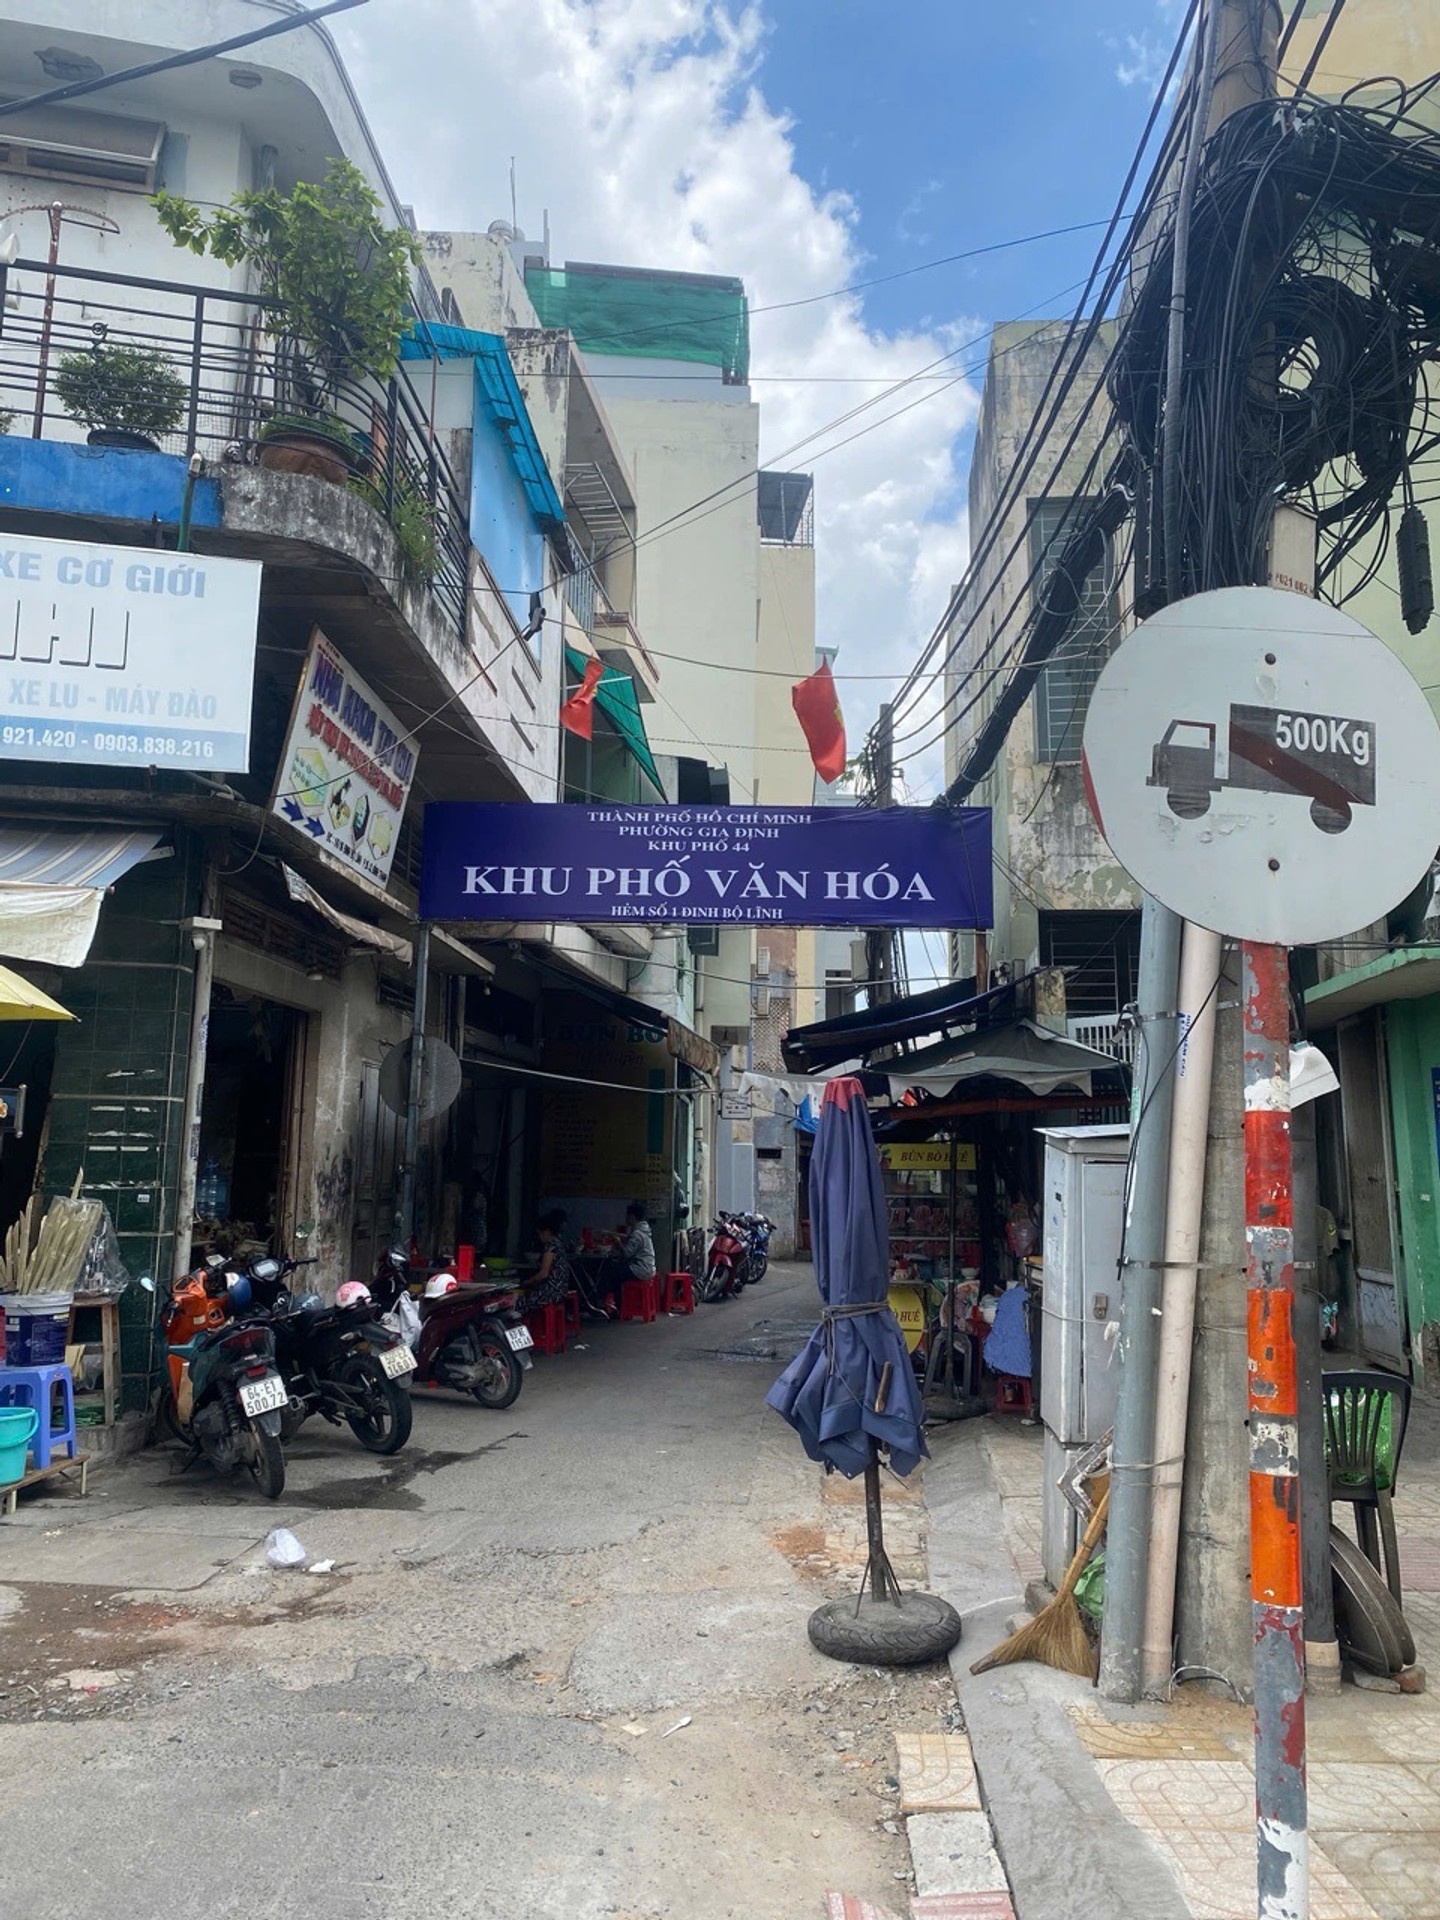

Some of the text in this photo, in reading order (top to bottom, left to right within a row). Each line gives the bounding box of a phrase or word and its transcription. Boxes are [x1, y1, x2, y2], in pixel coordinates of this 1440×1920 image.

[56, 556, 114, 588] CƠ
[126, 563, 206, 599] GIỚI
[8, 678, 42, 706] XE
[49, 681, 80, 709] LU
[105, 683, 161, 716] MÁY
[168, 686, 218, 720] ĐÀO
[3, 726, 76, 749] 921.420
[94, 733, 215, 758] 0903.838.216
[1276, 713, 1369, 766] 500Kg
[587, 808, 812, 825] THÀNH PHỐ HỒ CHÍ MINH
[618, 825, 779, 840] PHƯỜNG GIA ĐỊNH
[648, 837, 750, 852] KHU PHỐ 44
[462, 854, 936, 902] KHU PHỐ VĂN HÓA
[611, 902, 645, 918] HẺM
[648, 901, 668, 918] SỐ
[681, 907, 718, 919] ĐINH
[722, 905, 743, 921] BỘ
[746, 905, 782, 920] LĨNH
[247, 1380, 276, 1400] 64-E1
[247, 1392, 286, 1414] 500.72
